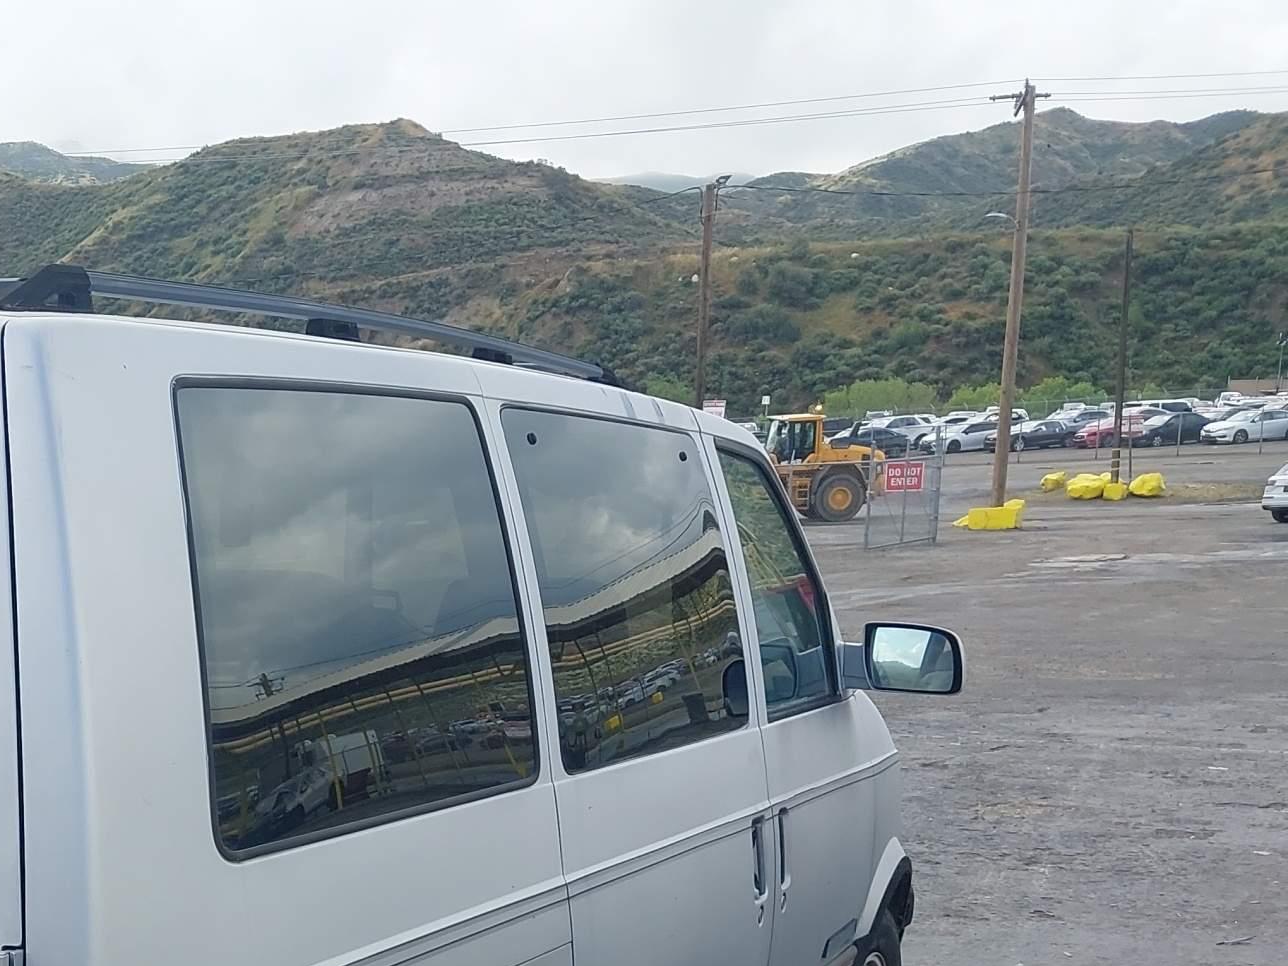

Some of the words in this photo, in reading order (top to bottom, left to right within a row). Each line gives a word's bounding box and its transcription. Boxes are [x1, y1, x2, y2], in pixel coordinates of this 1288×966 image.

[888, 468, 902, 477] DO
[904, 467, 921, 477] NOT
[891, 477, 918, 486] ENTER
